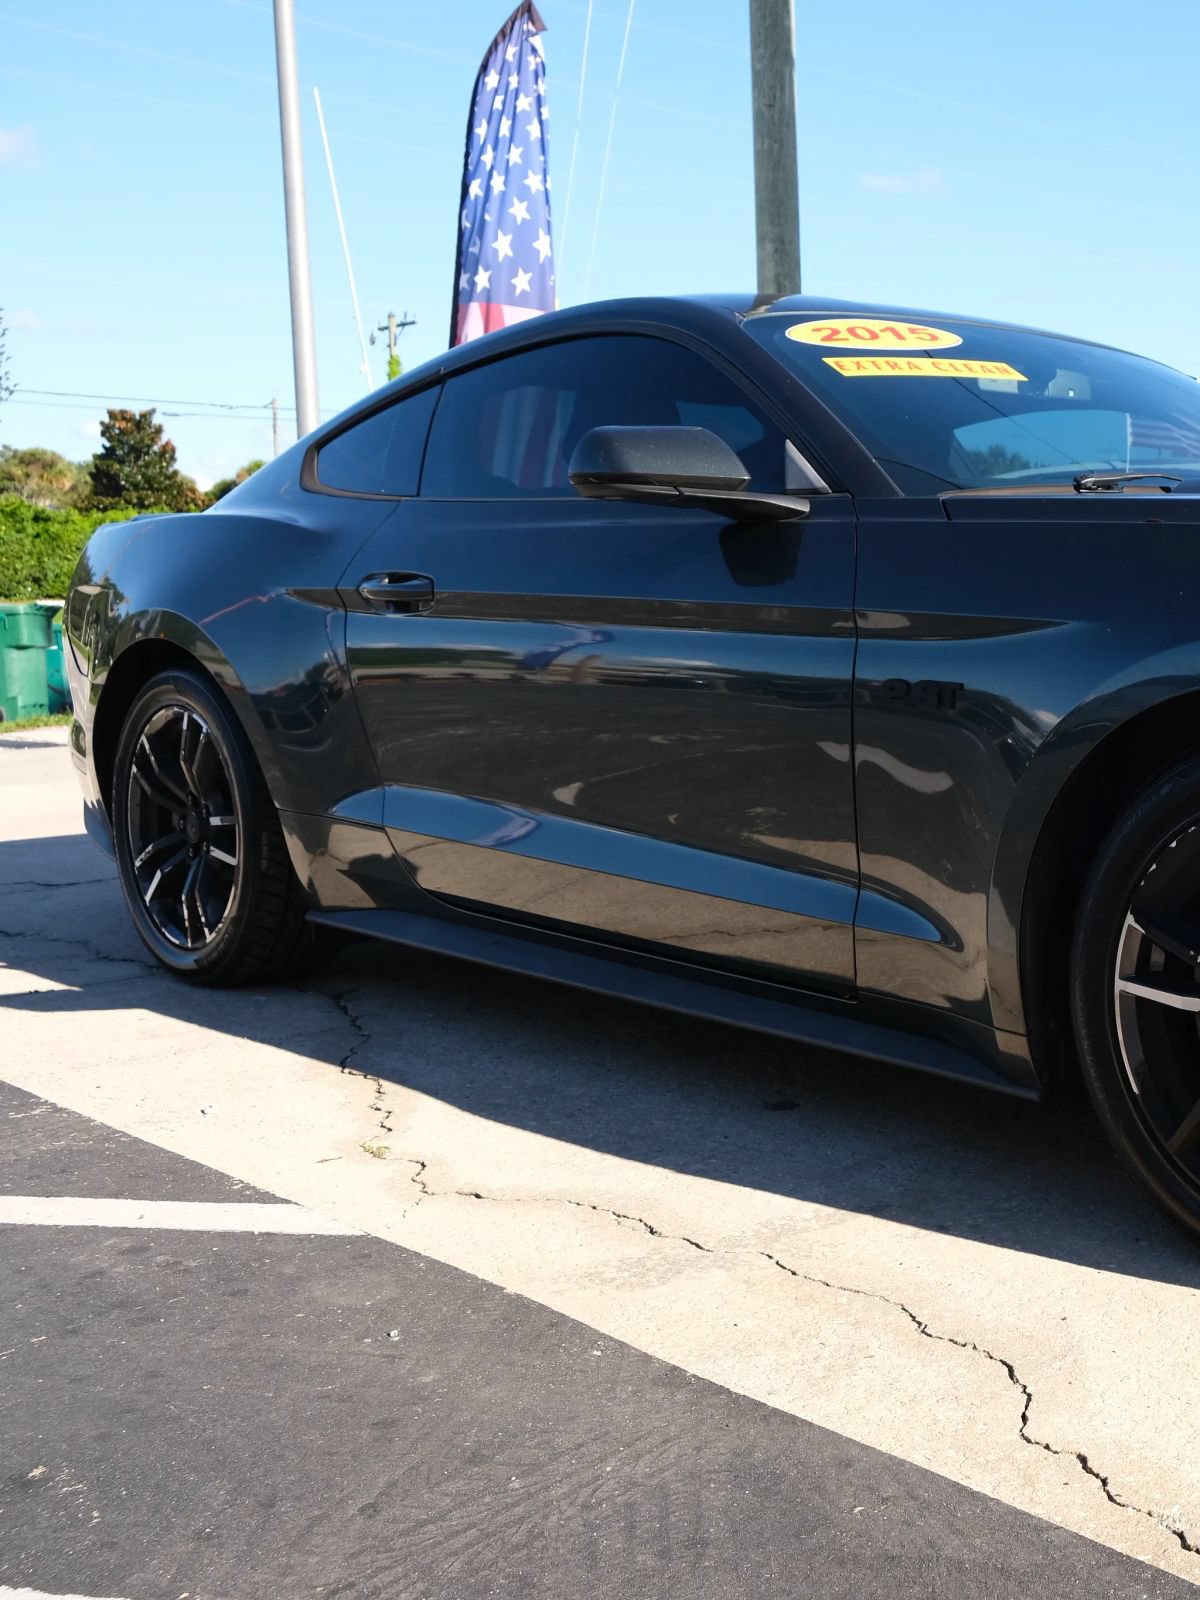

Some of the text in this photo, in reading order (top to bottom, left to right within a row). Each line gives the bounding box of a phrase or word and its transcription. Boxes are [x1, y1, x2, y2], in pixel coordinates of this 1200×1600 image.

[811, 326, 940, 343] 2015
[833, 360, 1017, 377] EXTRA CLEAN
